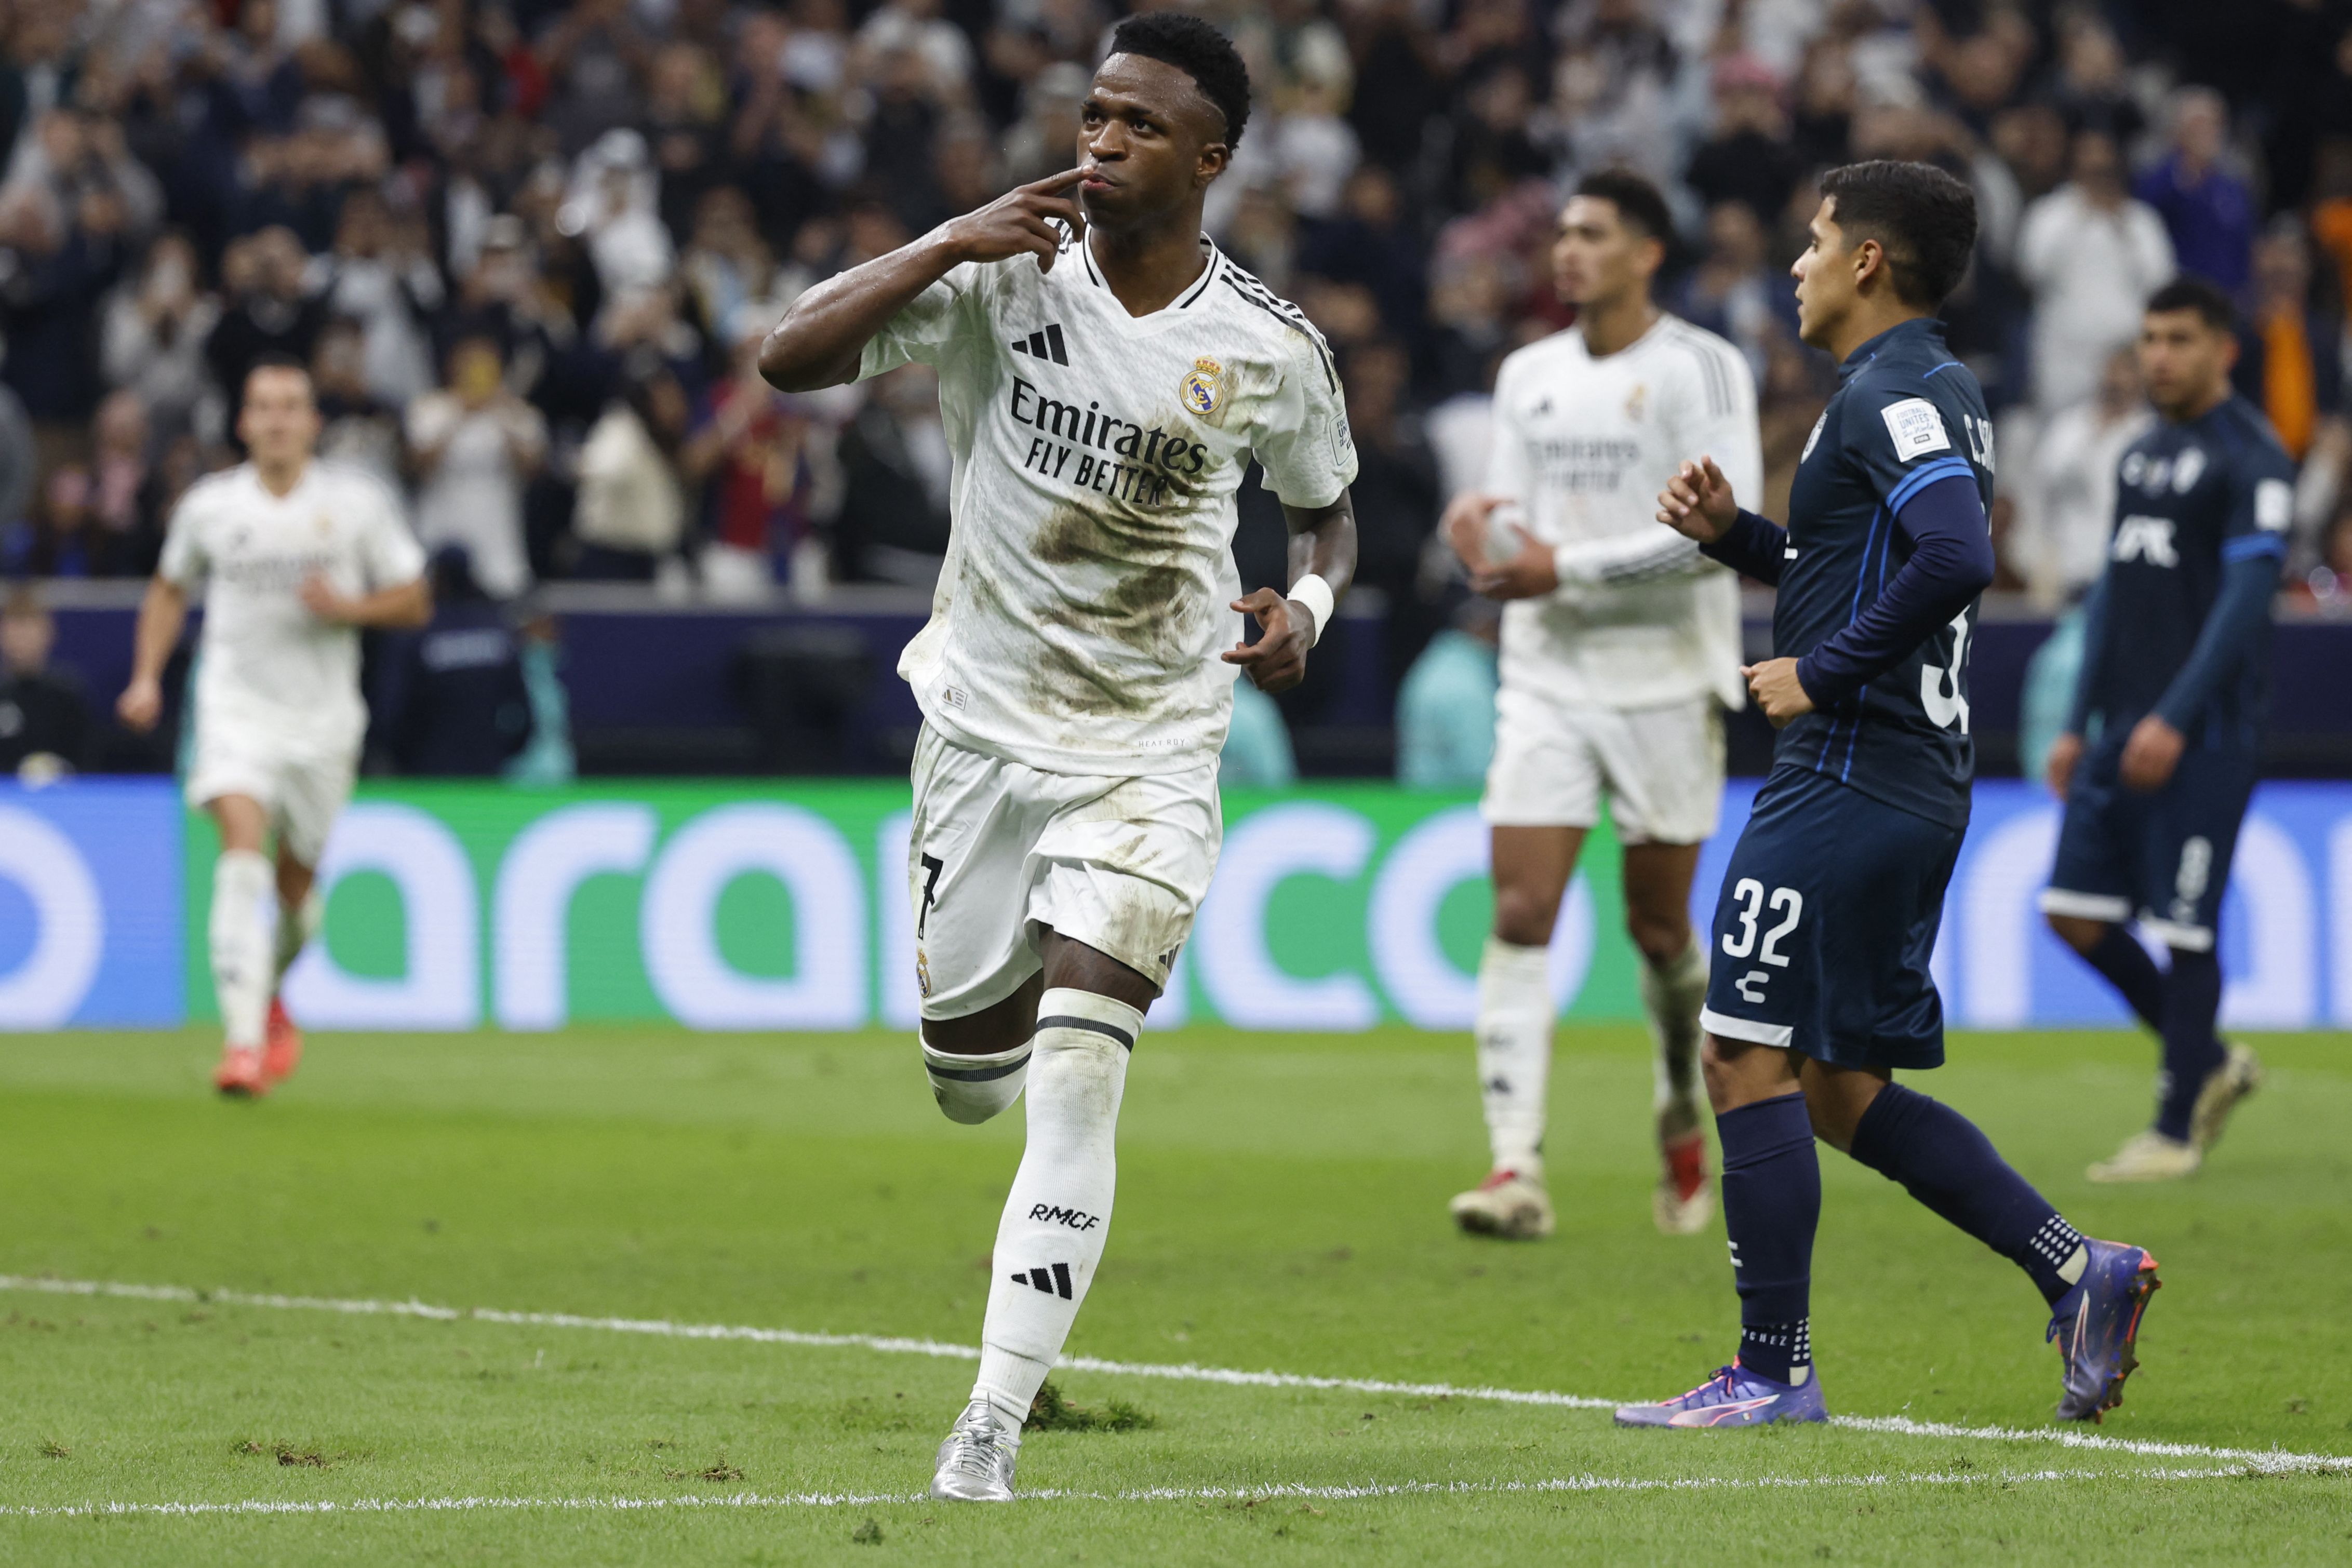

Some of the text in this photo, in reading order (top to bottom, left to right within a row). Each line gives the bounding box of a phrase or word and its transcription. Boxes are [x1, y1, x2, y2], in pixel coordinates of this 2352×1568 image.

[1011, 375, 1208, 474] Emirates
[1899, 413, 1930, 429] UNITES
[1024, 437, 1169, 507] FLY BETTER
[1920, 604, 1974, 735] 3
[279, 799, 1596, 1031] araco
[918, 852, 944, 941] 7
[1721, 877, 1803, 968] 32
[1028, 1203, 1100, 1231] RMCF
